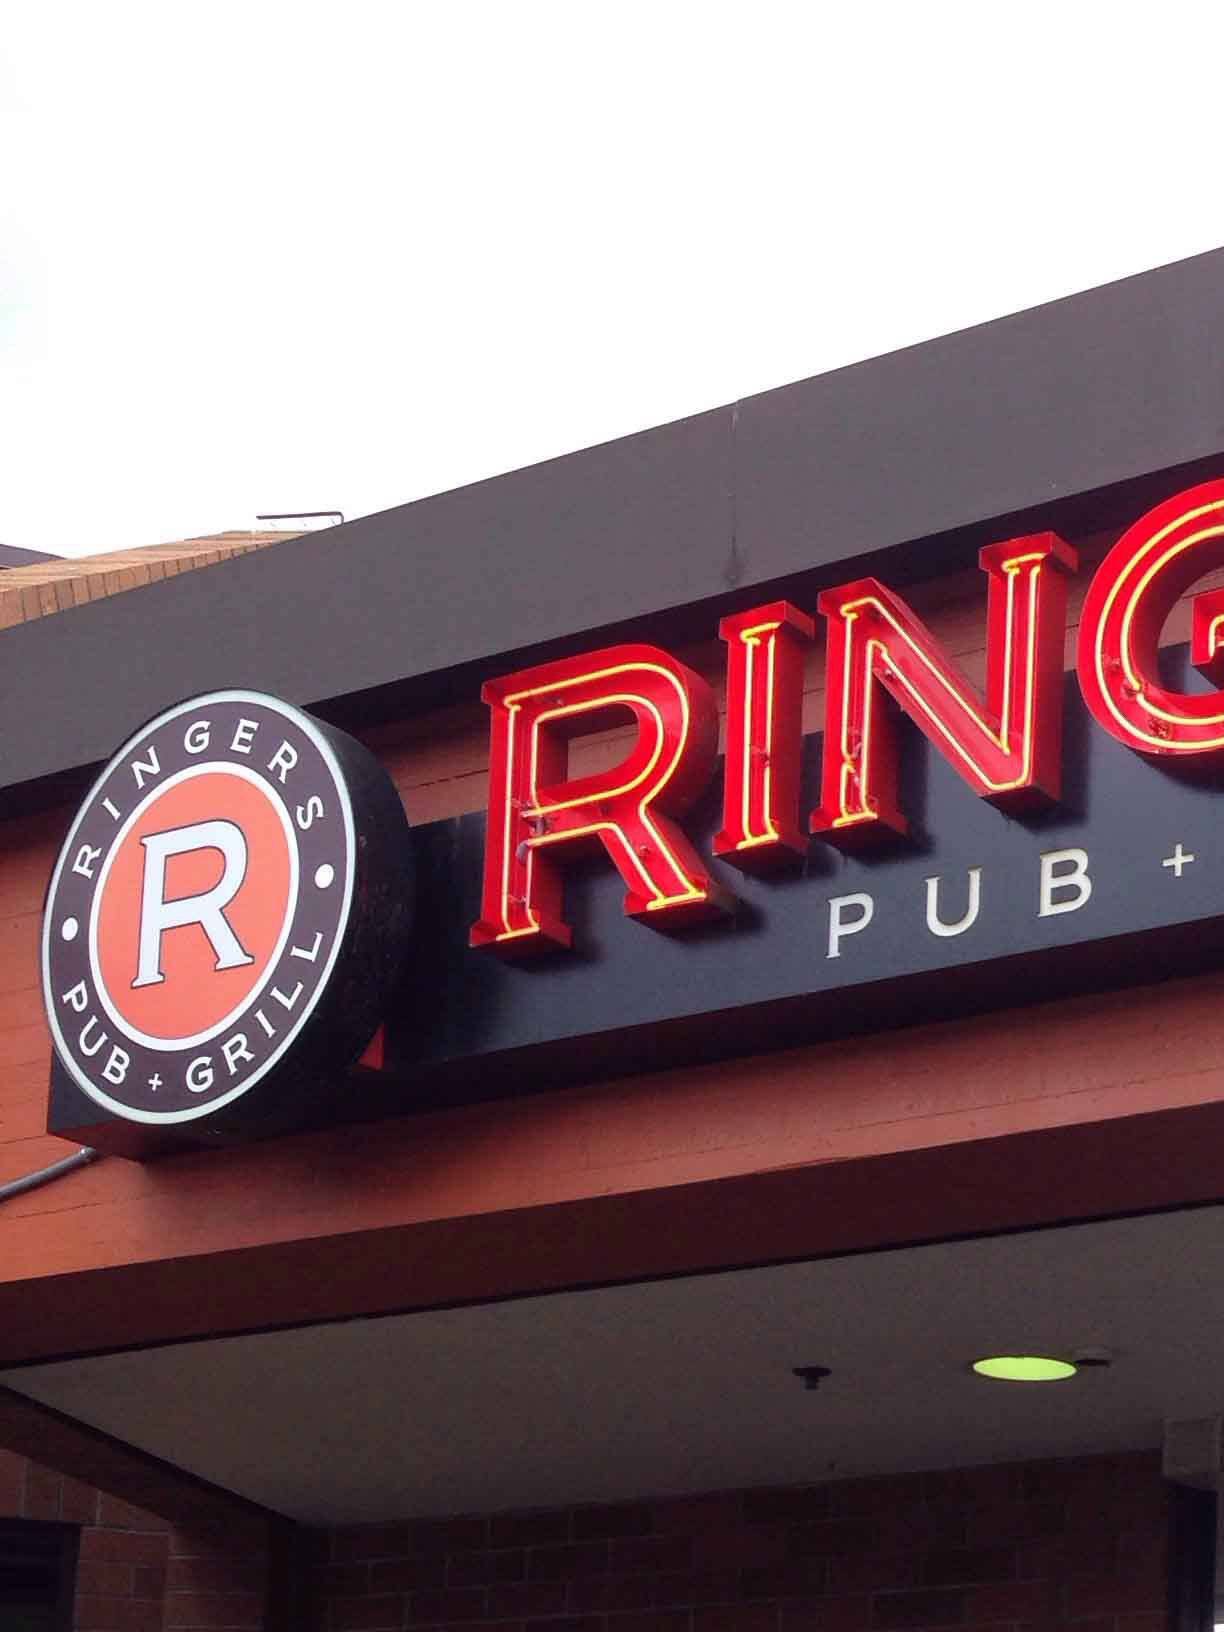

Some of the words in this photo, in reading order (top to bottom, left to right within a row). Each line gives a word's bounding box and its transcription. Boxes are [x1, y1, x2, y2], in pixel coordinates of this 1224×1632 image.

[72, 719, 325, 879] RINGERS
[131, 818, 255, 989] R
[826, 848, 1093, 960] PUB
[62, 981, 131, 1085] PUB
[185, 932, 324, 1093] GRILL
